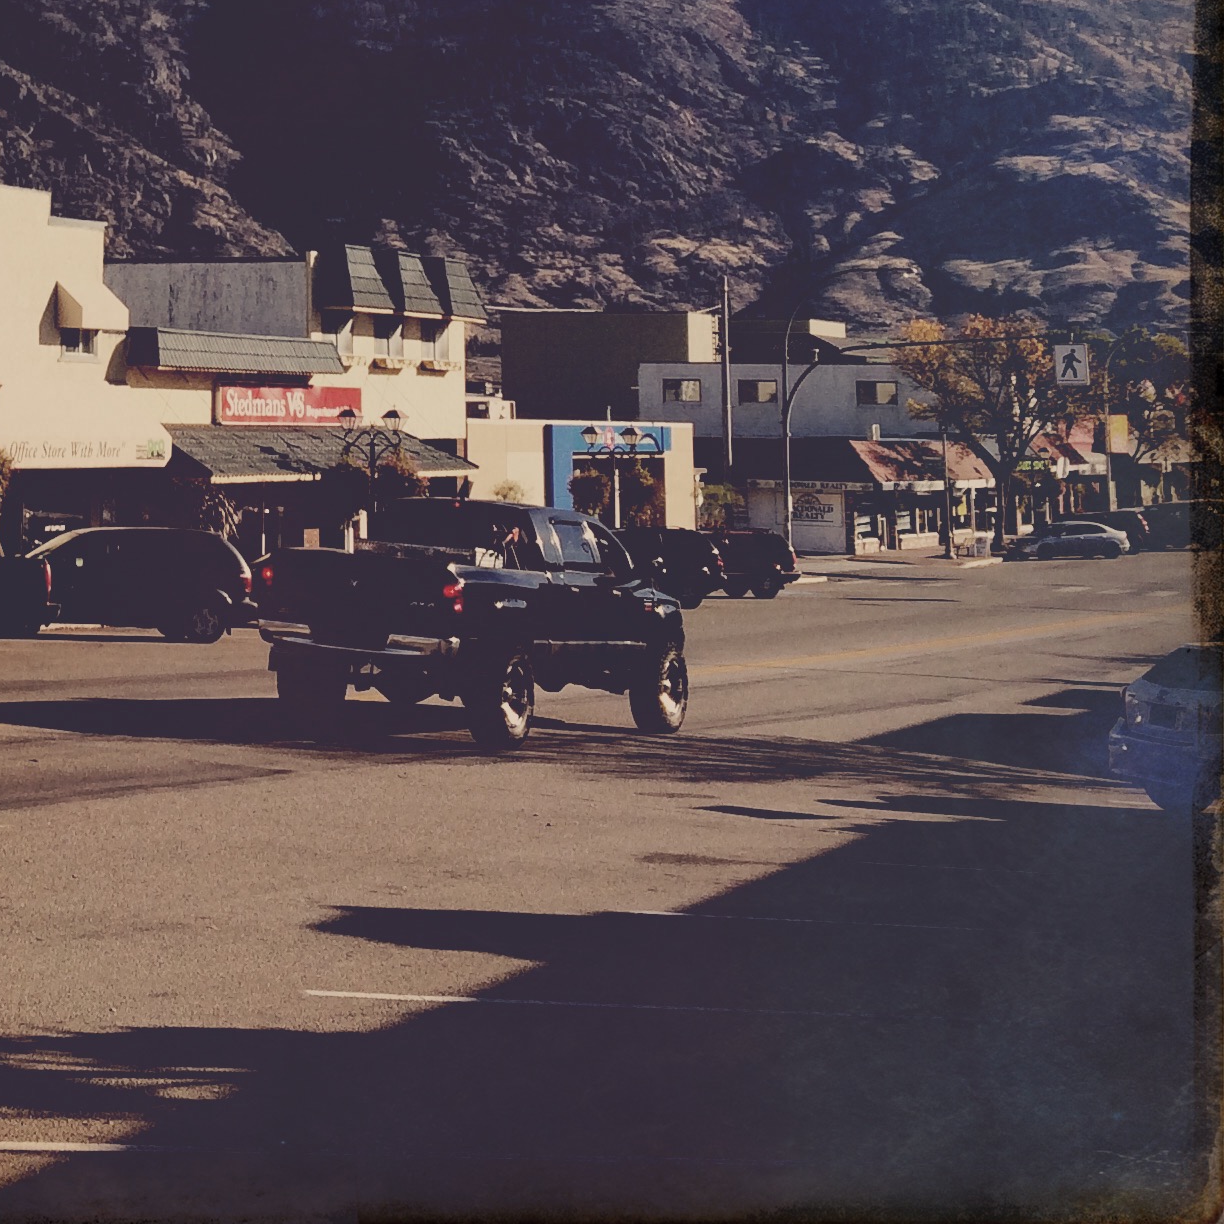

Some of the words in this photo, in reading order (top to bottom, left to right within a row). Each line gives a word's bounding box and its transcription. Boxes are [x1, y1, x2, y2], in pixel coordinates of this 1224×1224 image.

[225, 388, 286, 417] Stedmans
[9, 441, 37, 463] Office
[41, 441, 66, 458] Store
[71, 440, 93, 458] With
